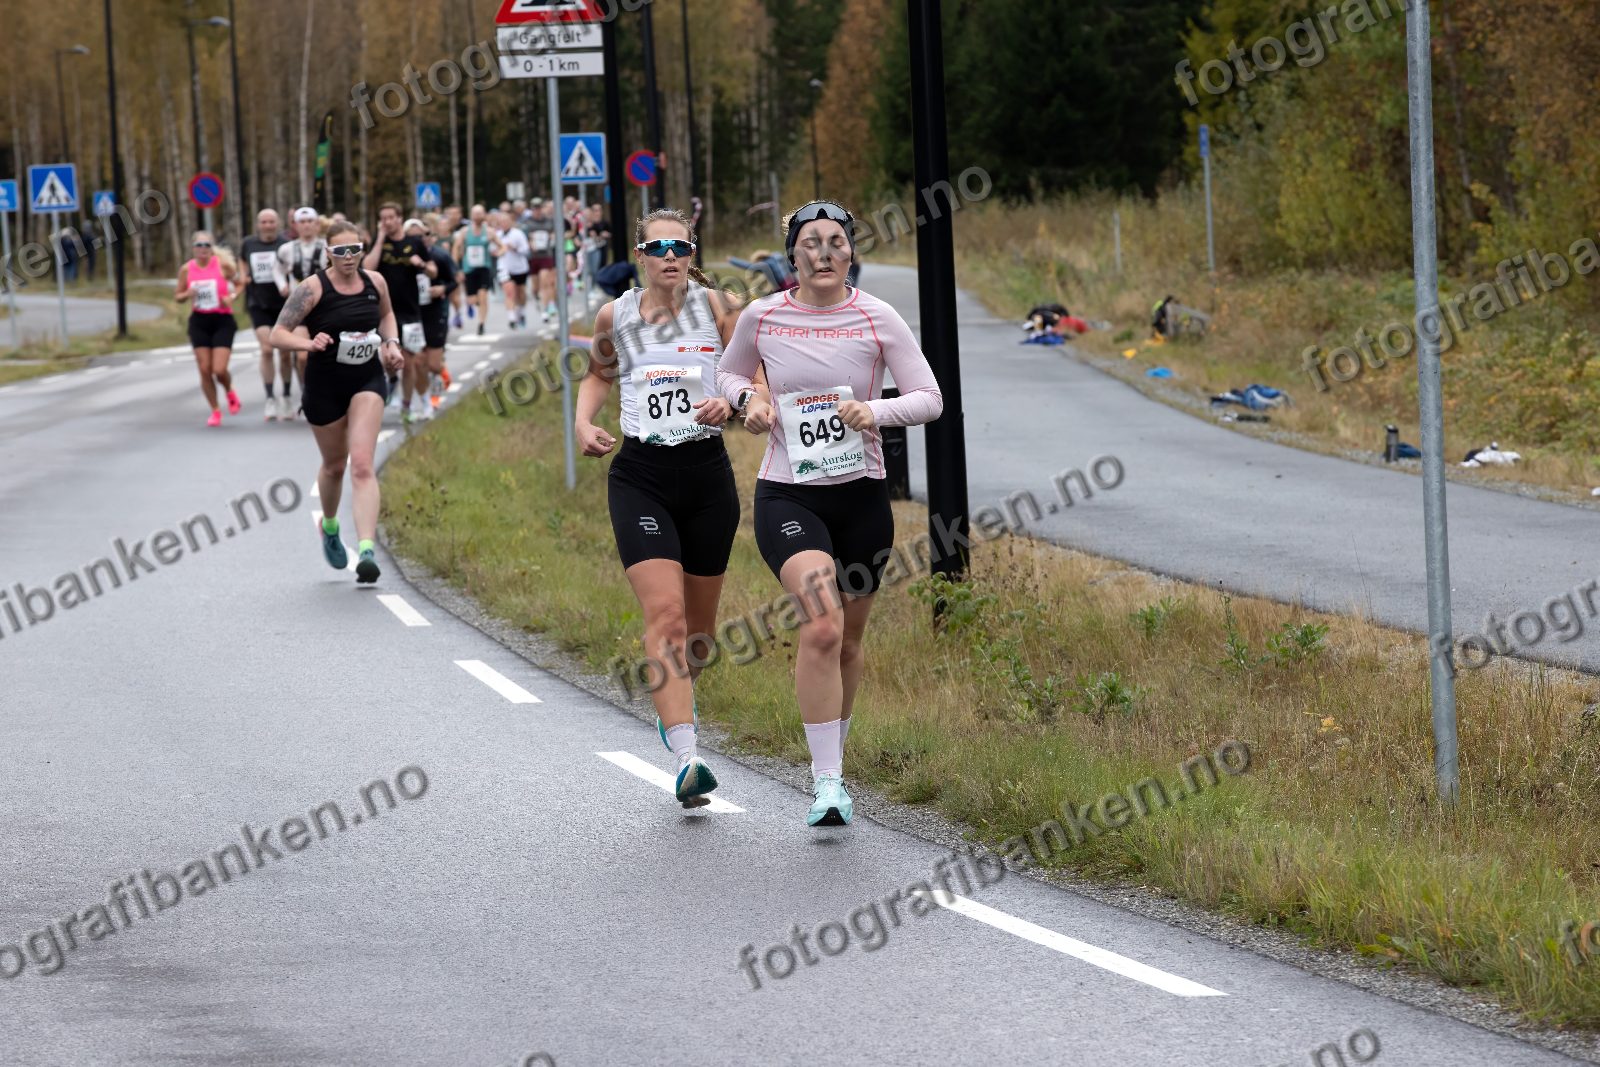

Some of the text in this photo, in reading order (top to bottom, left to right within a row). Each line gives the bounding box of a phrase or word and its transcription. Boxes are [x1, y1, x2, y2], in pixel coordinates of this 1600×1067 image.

[559, 59, 580, 71] km
[768, 326, 863, 339] KARI TRAA
[347, 344, 373, 359] 420
[650, 377, 681, 387] LØPET
[648, 389, 691, 420] 873
[794, 394, 840, 406] NORGES
[802, 402, 834, 414] LØPET
[800, 415, 846, 447] 649
[821, 451, 862, 466] Aurskog
